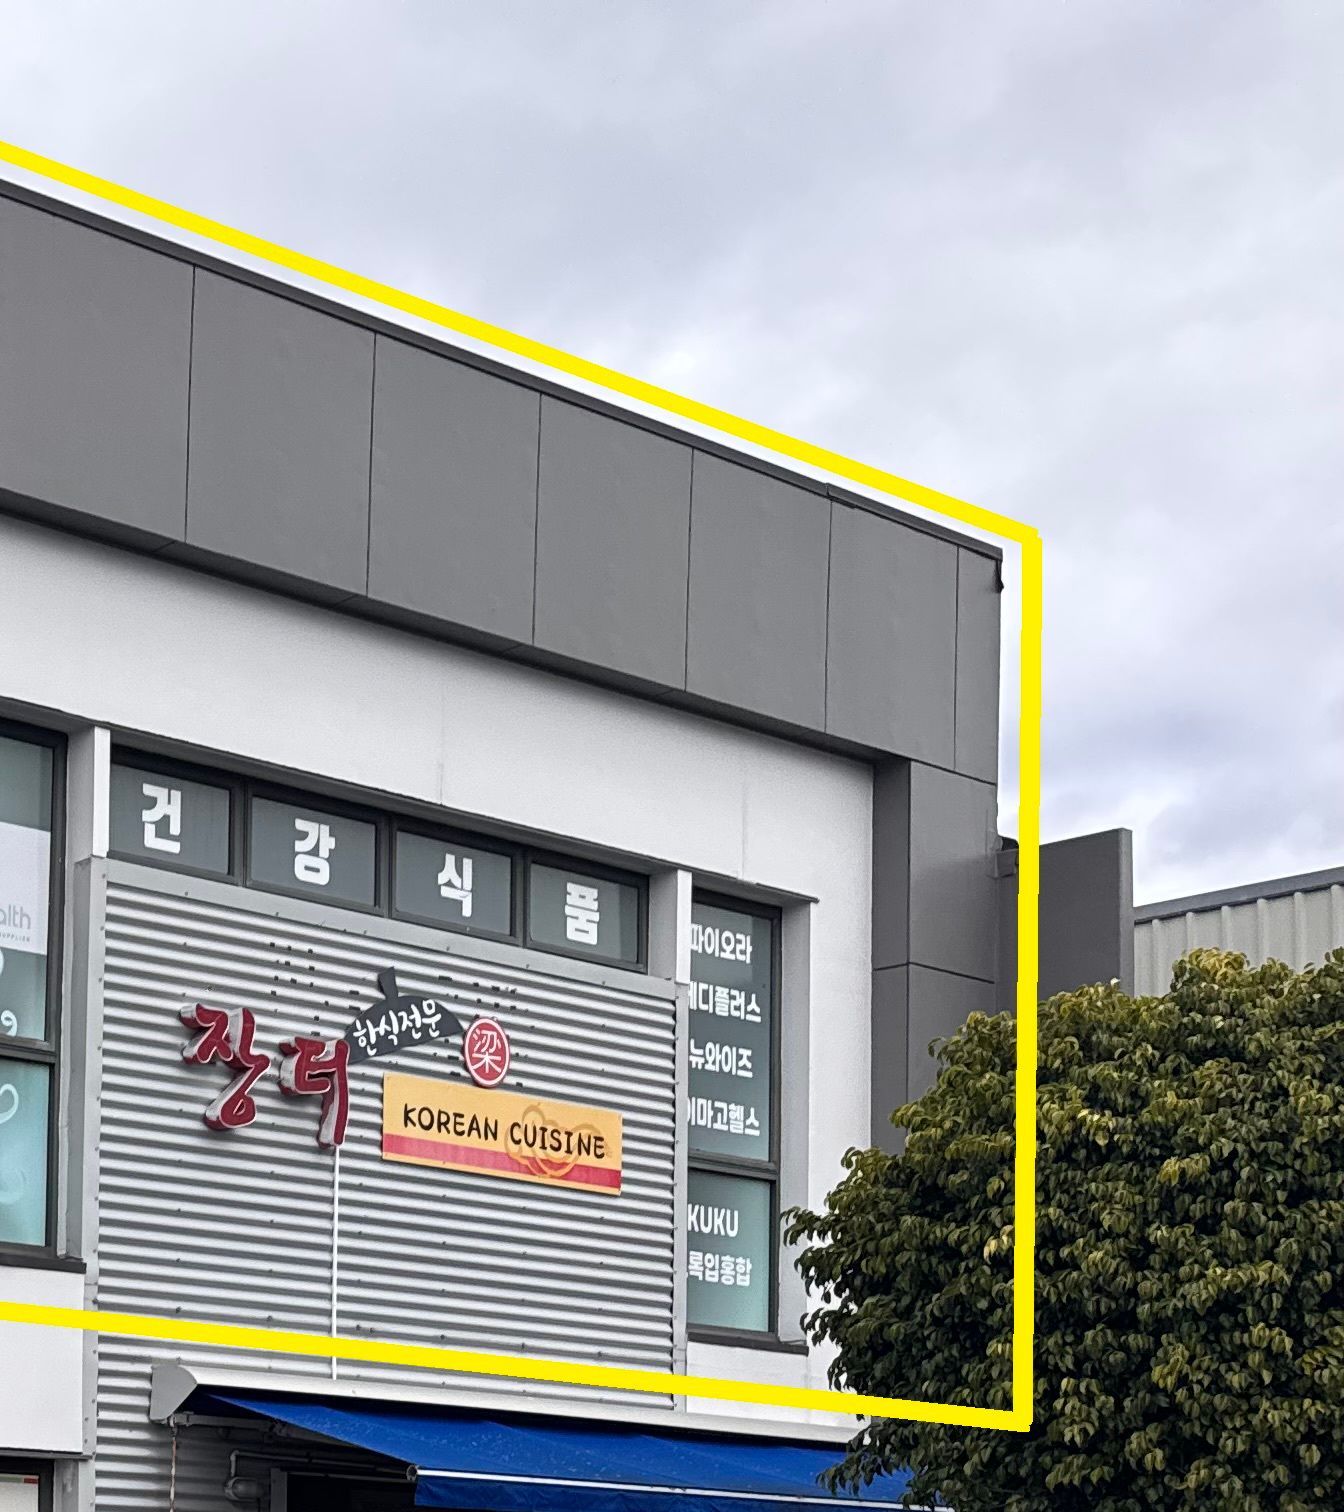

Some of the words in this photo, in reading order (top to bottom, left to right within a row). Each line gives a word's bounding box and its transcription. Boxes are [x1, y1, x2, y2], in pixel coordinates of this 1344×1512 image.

[141, 782, 600, 946] 건강식품
[353, 1000, 442, 1057] 한식전문
[178, 1002, 352, 1149] 장터
[689, 1038, 753, 1078] 뉴와이즈
[403, 1102, 499, 1142] KOREAN
[509, 1121, 607, 1160] CUISINE
[687, 1203, 739, 1238] KUKU
